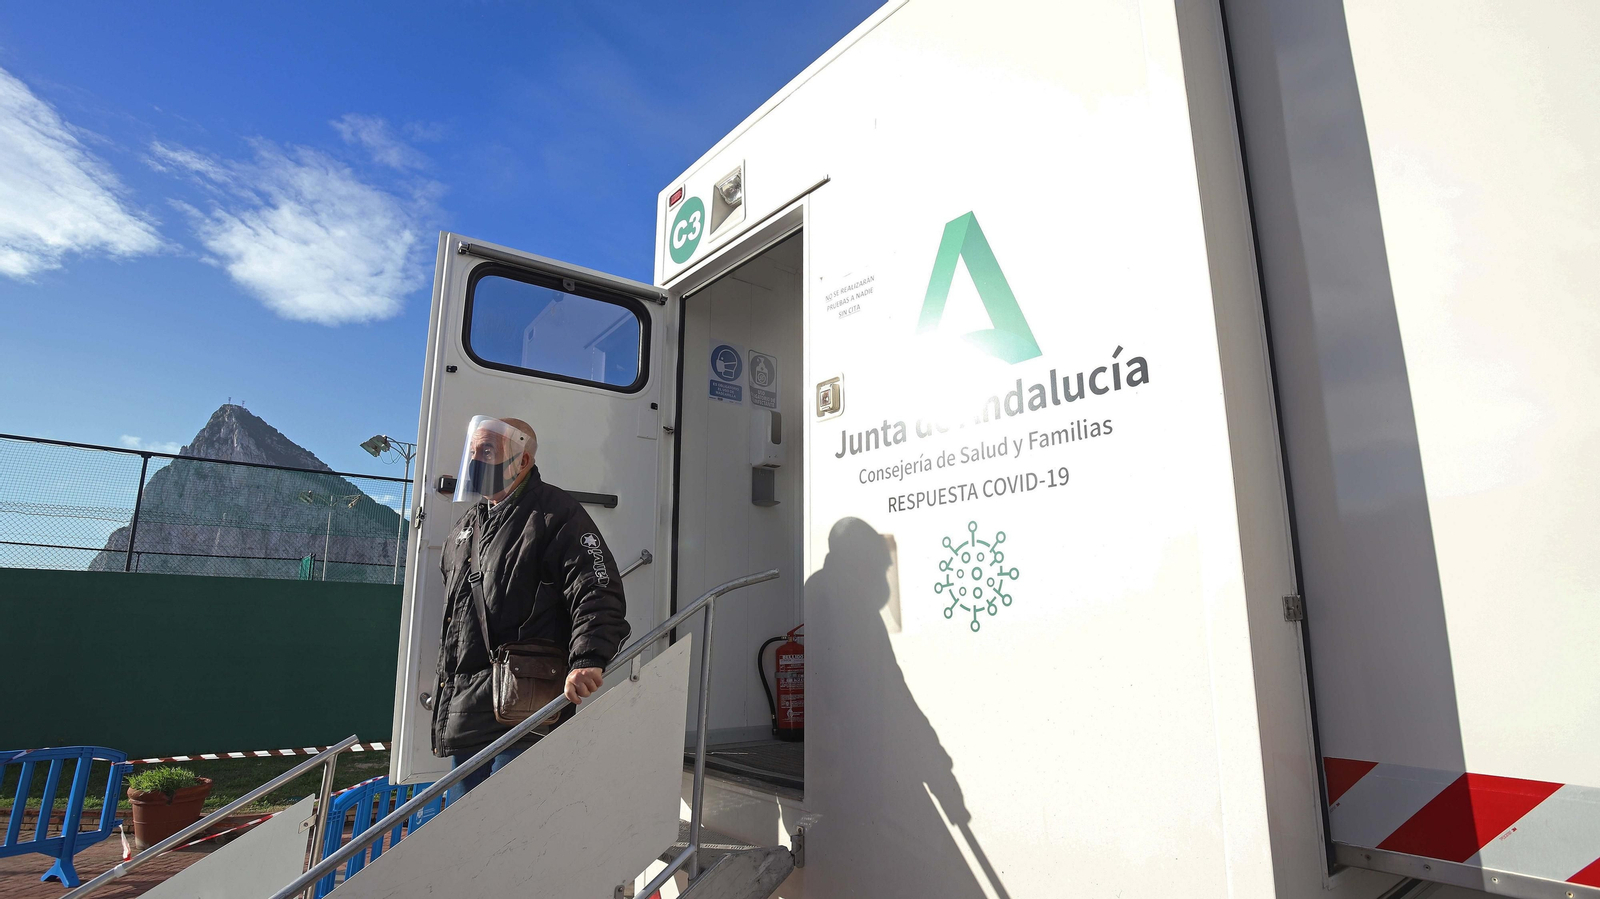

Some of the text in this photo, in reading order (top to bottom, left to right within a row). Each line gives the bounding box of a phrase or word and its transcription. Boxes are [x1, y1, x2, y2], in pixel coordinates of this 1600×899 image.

[672, 210, 701, 250] C3
[826, 293, 833, 302] NO
[833, 289, 840, 298] SE
[826, 297, 850, 312] PRUEBAS
[856, 287, 873, 299] NADIE
[838, 303, 861, 318] SIN CITA
[834, 420, 907, 460] Junta
[959, 345, 1150, 429] ndalucía
[859, 418, 1114, 485] Consejería de Salud y Familias
[888, 466, 1070, 513] RESPUESTA COVID-19
